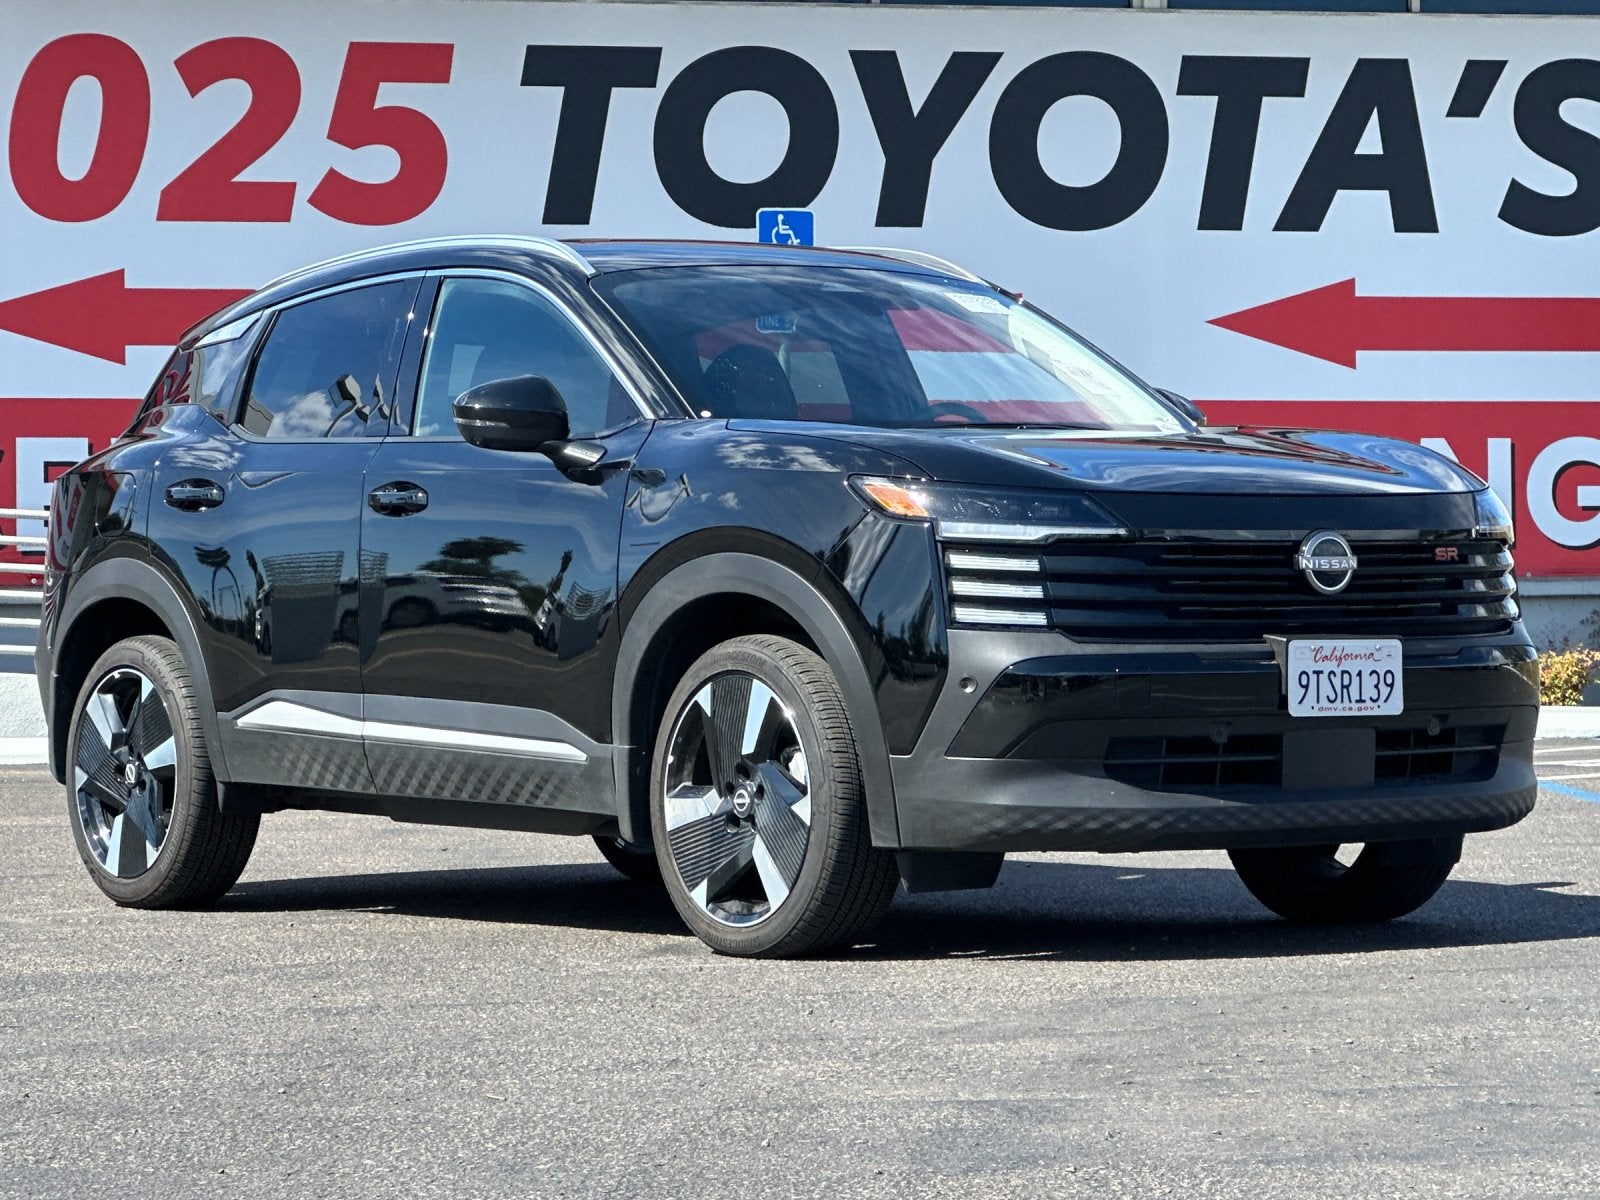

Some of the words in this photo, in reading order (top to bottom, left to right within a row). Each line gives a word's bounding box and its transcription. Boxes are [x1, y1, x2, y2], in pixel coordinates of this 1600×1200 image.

[8, 33, 455, 226] 025
[520, 44, 1600, 238] TOYOTA'S
[1435, 547, 1460, 561] SR
[1301, 557, 1358, 570] NISSAN
[1313, 645, 1382, 668] California
[1297, 669, 1396, 705] 9TSR139
[1317, 705, 1376, 713] dmv.ca.gov
